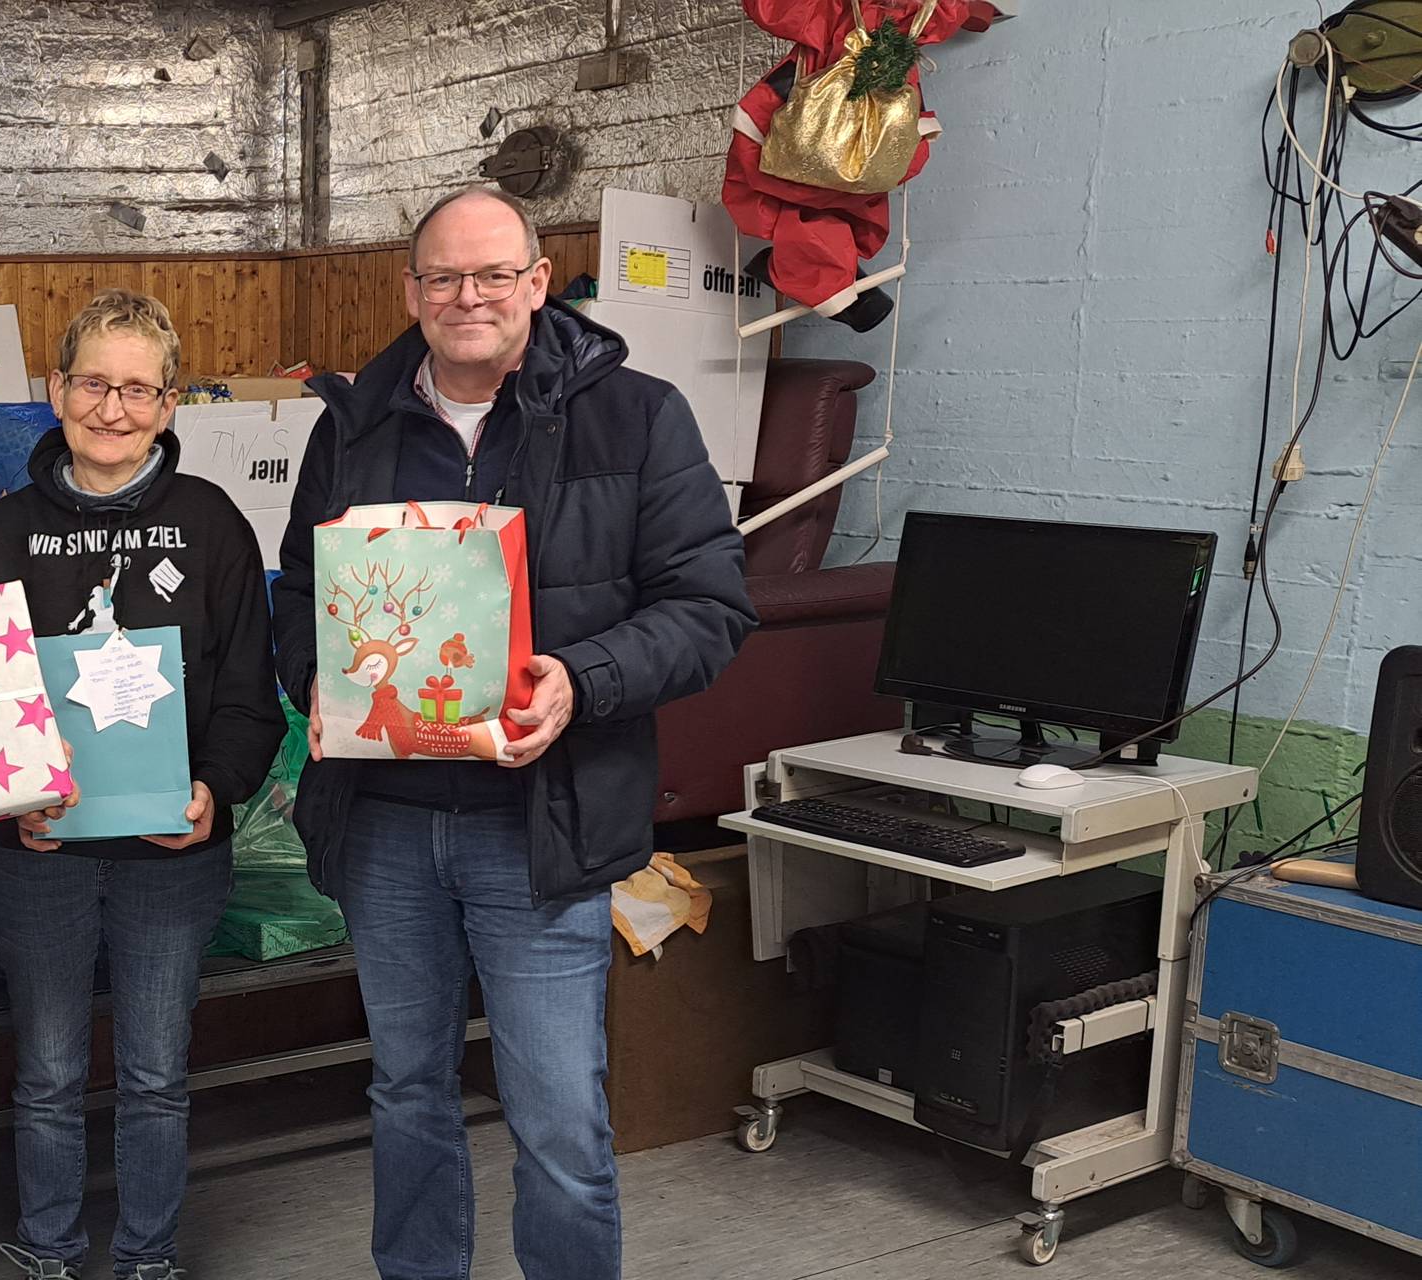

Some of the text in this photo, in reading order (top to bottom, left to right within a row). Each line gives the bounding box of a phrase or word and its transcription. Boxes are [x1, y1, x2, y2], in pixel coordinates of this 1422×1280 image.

[703, 264, 761, 298] öffnen!
[248, 458, 289, 484] Hier
[28, 525, 187, 557] WIR SIND AM ZIEL
